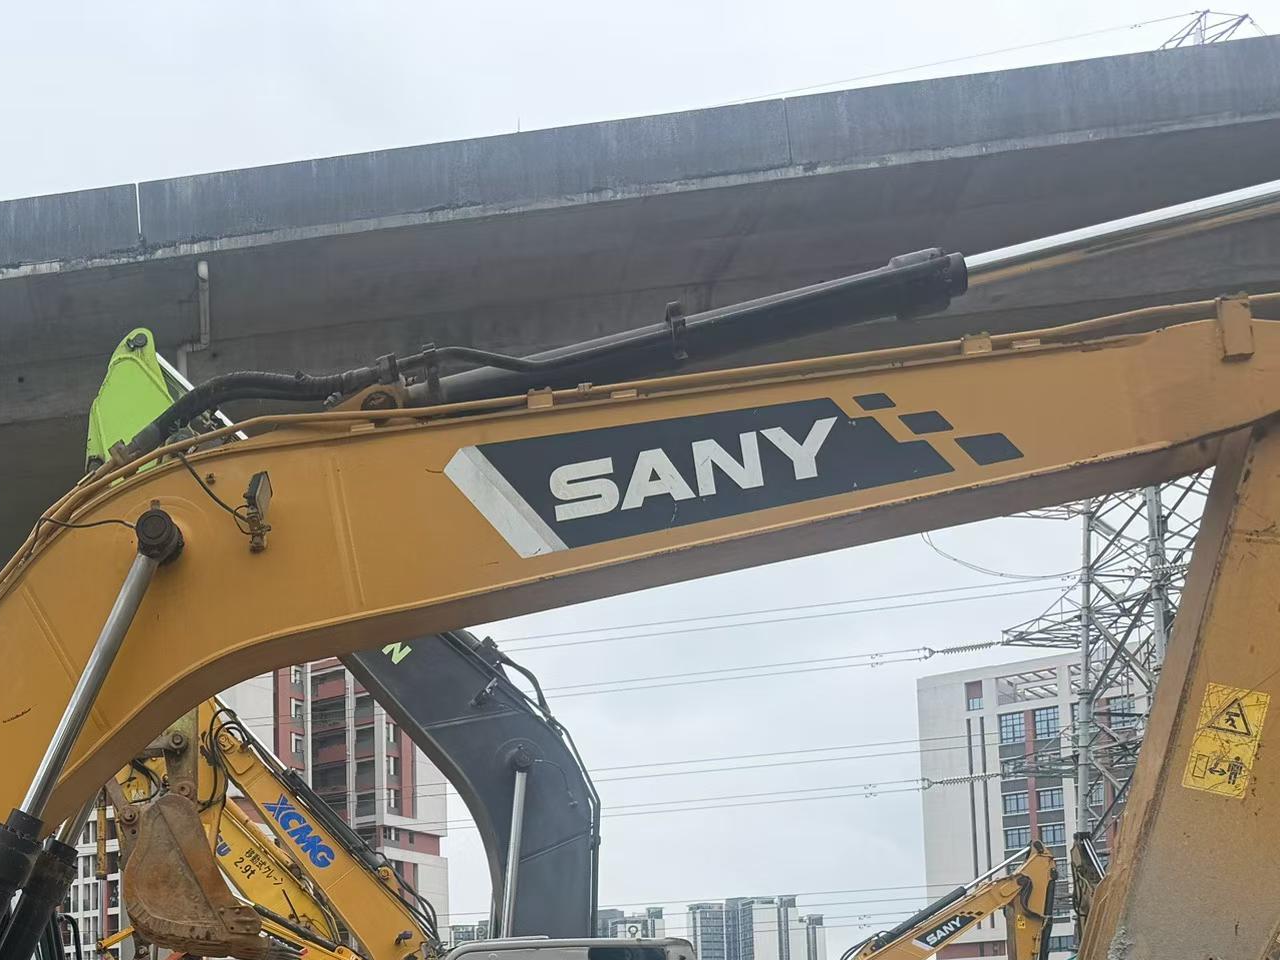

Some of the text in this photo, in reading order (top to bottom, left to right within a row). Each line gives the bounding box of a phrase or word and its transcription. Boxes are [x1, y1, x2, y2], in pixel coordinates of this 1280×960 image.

[549, 416, 838, 522] SANY
[261, 793, 335, 869] XCMG
[234, 857, 256, 880] 2.9t
[926, 917, 962, 945] SANY
